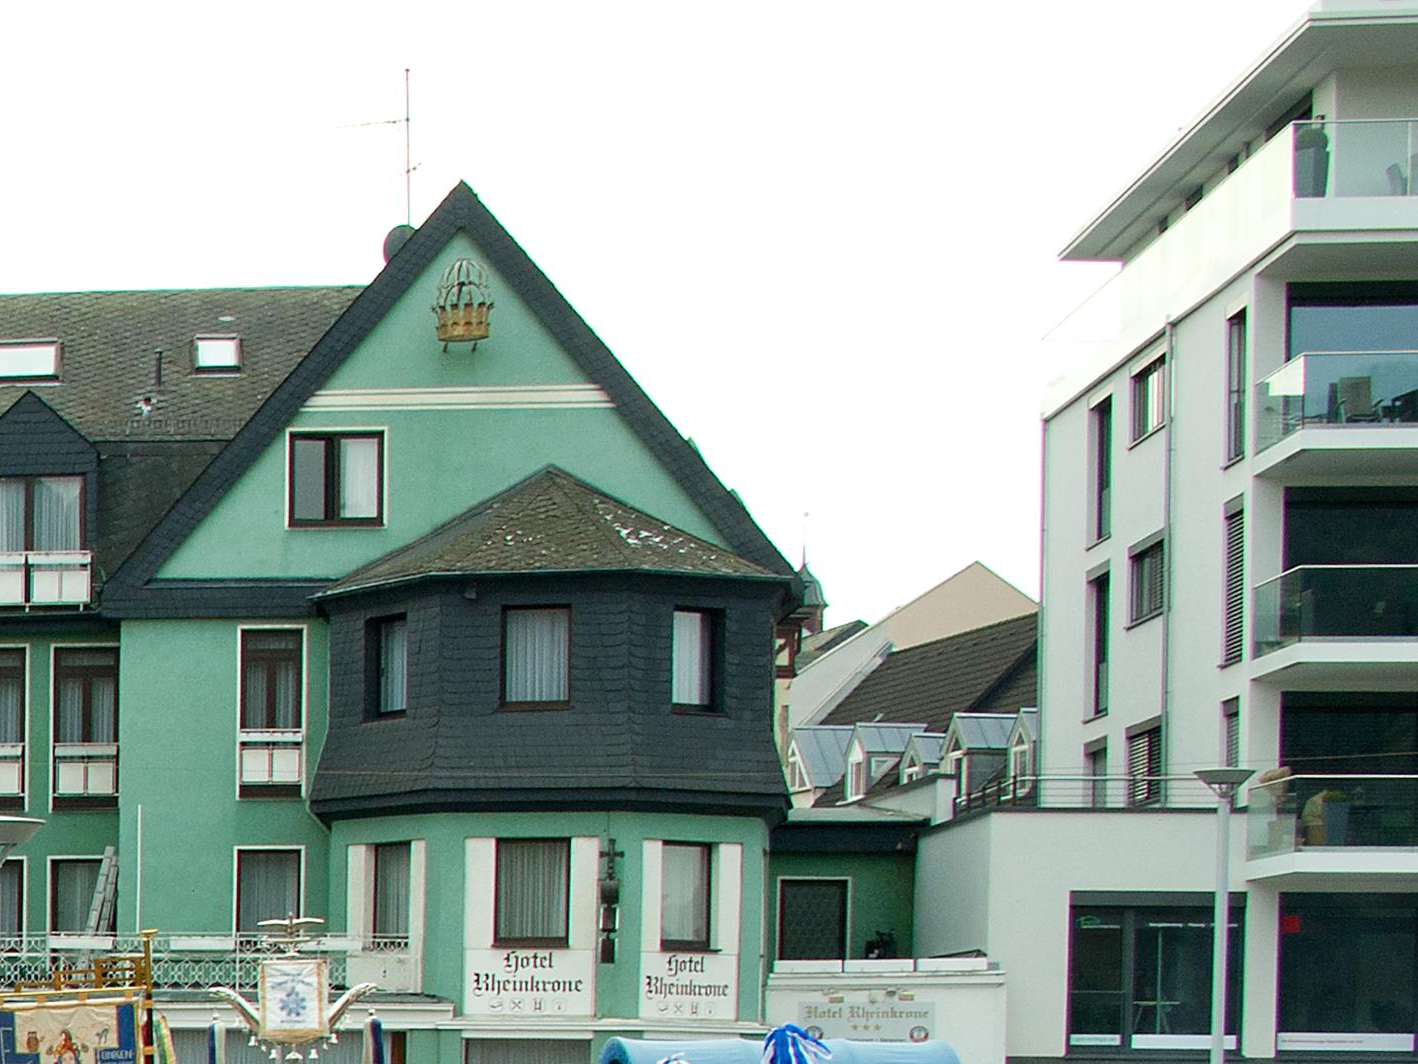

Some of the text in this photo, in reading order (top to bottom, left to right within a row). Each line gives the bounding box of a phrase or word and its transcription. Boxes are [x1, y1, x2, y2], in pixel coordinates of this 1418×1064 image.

[503, 951, 554, 973] Hotel
[666, 954, 705, 977] Hotel
[472, 972, 583, 996] Rheinkrone
[645, 975, 729, 1000] Rheinkrone
[804, 1004, 929, 1022] Hotel Rheinkrone
